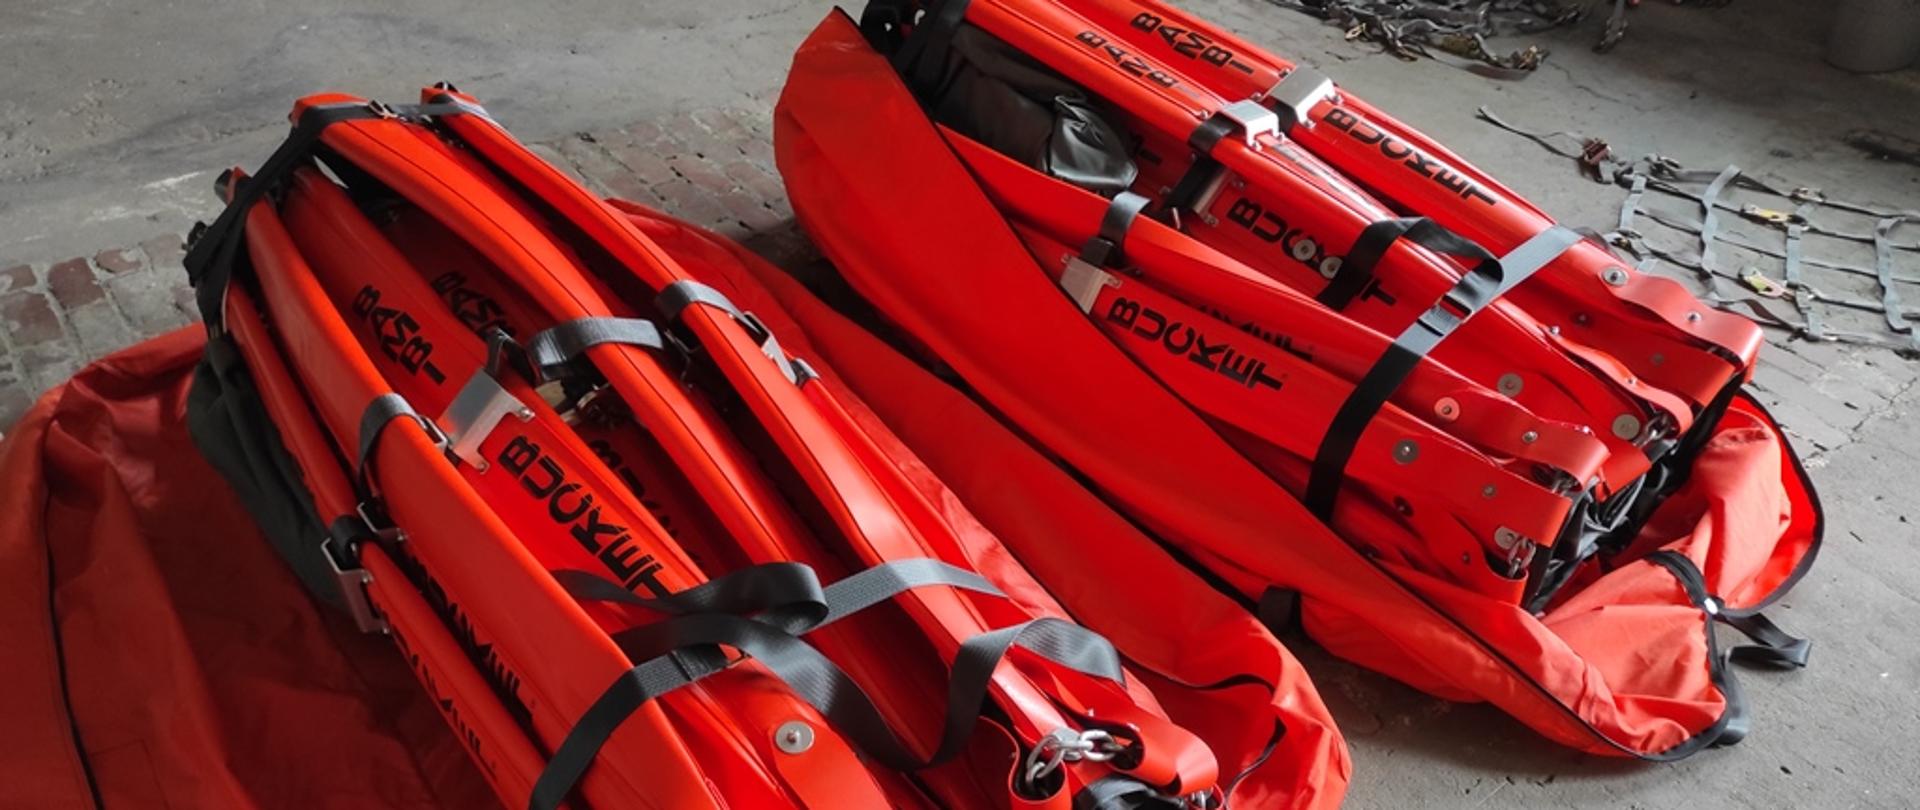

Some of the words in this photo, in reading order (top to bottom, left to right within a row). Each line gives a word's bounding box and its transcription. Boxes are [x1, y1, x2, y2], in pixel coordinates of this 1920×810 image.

[1130, 13, 1254, 75] BAMBI
[1323, 108, 1496, 206] BUCKET
[352, 284, 447, 385] BAMBI
[1106, 296, 1283, 391] BUCKET
[498, 435, 673, 599] BUCKET
